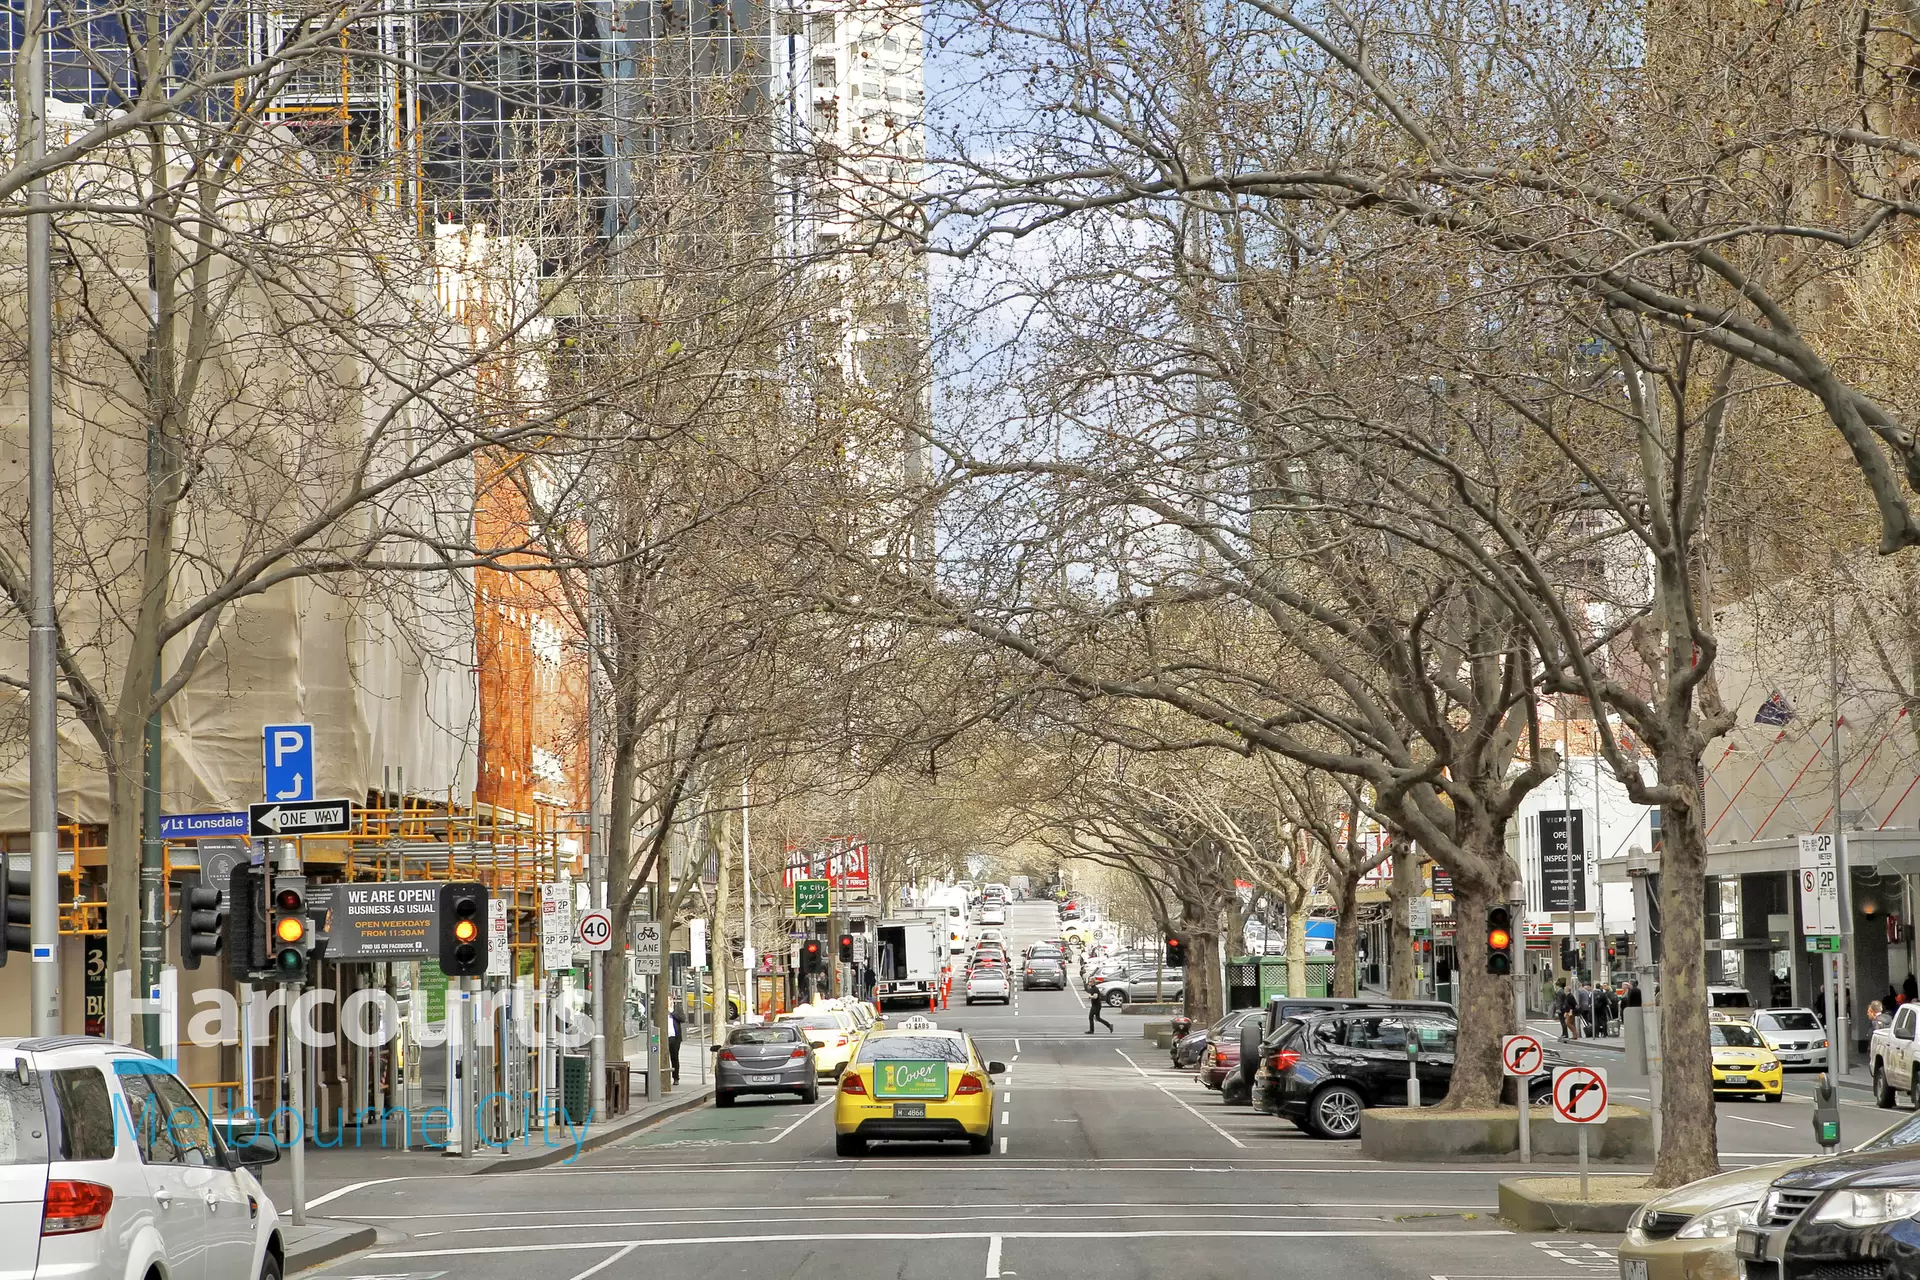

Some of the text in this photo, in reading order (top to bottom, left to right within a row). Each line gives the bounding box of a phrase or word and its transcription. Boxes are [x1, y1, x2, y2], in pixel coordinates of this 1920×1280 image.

[274, 731, 304, 768] P
[172, 816, 244, 830] Lt Lonsdale
[280, 810, 339, 826] ONE WAY
[1818, 836, 1831, 851] 2P
[1820, 872, 1834, 886] 2P
[348, 889, 436, 903] WE ARE OPEN!
[348, 904, 436, 914] BUSINESS AS USUAL
[558, 901, 568, 909] 2P
[584, 922, 607, 937] 40
[498, 938, 506, 948] 2P
[546, 936, 555, 944] 2P
[637, 944, 659, 952] LANE
